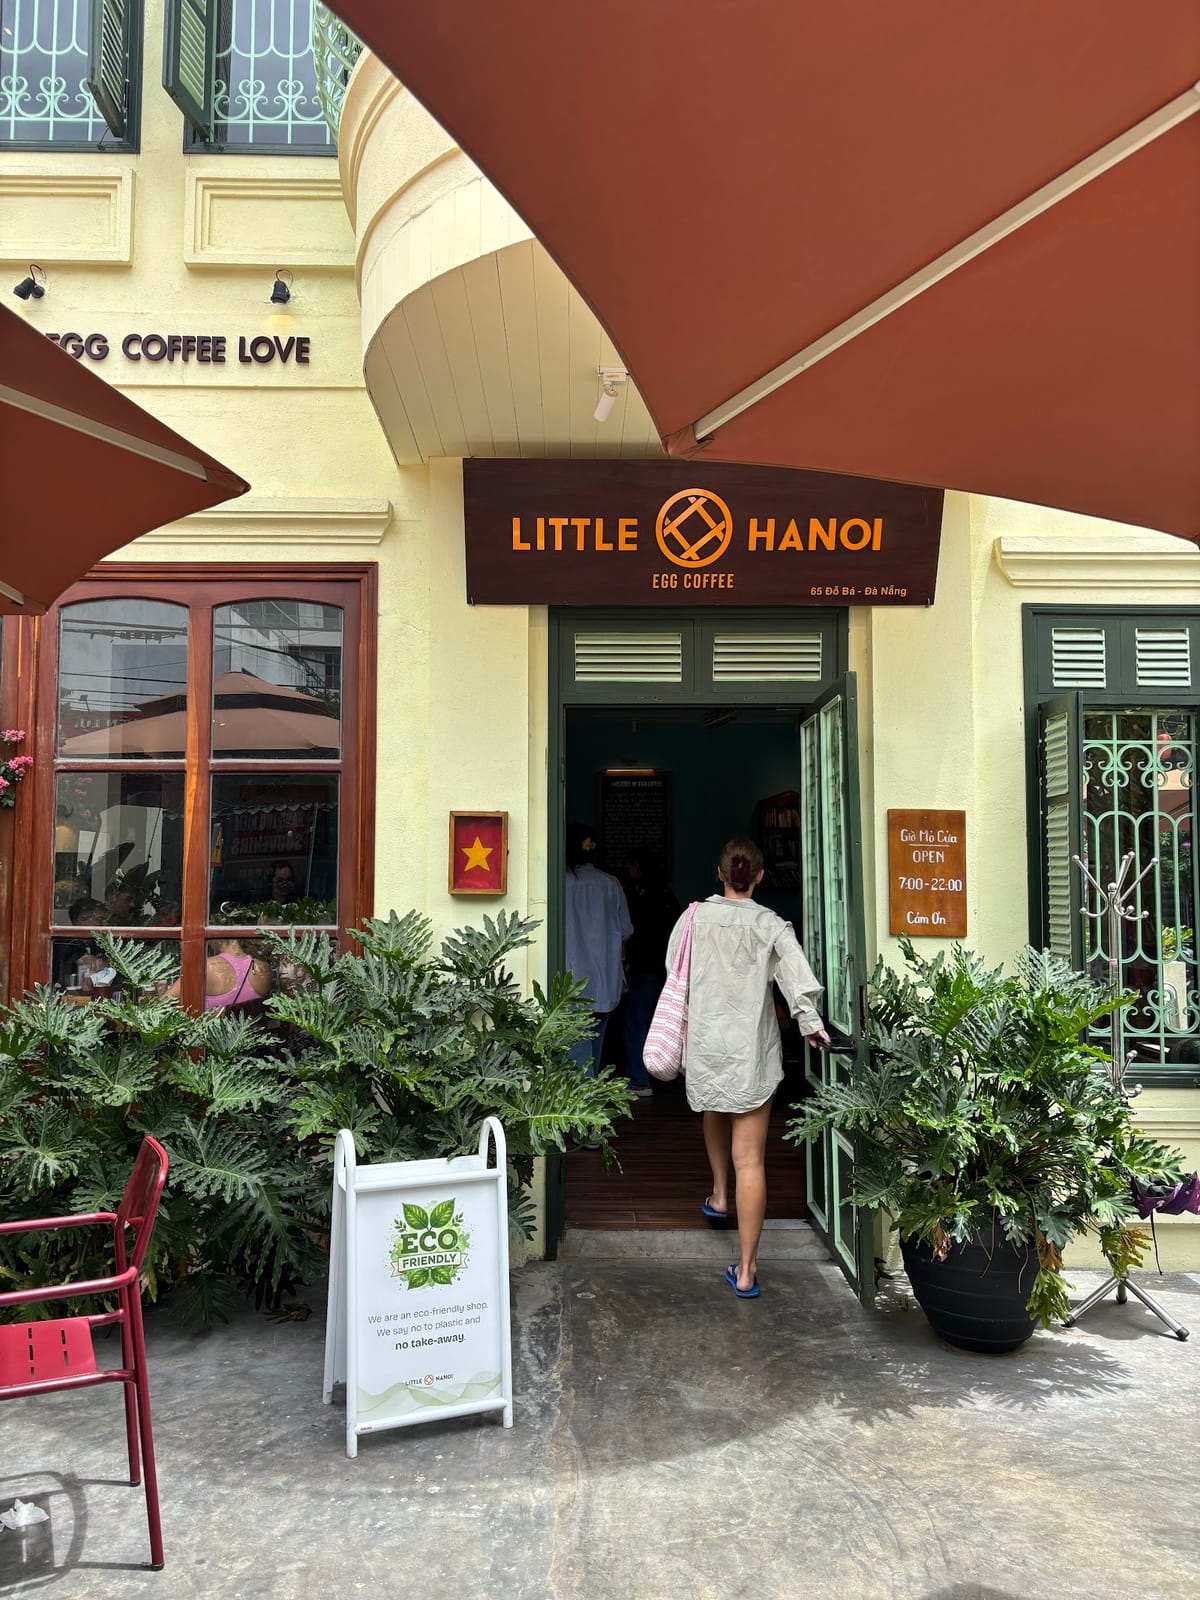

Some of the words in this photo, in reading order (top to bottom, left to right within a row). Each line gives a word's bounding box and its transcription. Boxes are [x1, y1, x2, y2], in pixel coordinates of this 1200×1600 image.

[122, 333, 226, 362] COFFEE
[238, 335, 311, 364] LOVE
[511, 517, 638, 551] LITTLE
[748, 517, 883, 551] HANOI
[652, 573, 678, 589] EGG
[683, 573, 734, 589] COFFEE
[810, 586, 823, 596] 65
[842, 586, 855, 596] Bá
[864, 586, 878, 596] Đà
[912, 850, 945, 863] OPEN
[400, 1229, 459, 1254] ECO
[402, 1253, 458, 1269] FRIENDLY
[368, 1315, 382, 1324] We
[384, 1314, 398, 1322] are
[400, 1312, 411, 1320] an
[413, 1304, 465, 1319] eco-friendly
[466, 1302, 489, 1313] shop.
[376, 1328, 391, 1337] We
[392, 1327, 409, 1336] say
[410, 1325, 422, 1333] no
[424, 1323, 433, 1331] to
[435, 1318, 463, 1330] plastic
[464, 1315, 481, 1325] and
[395, 1341, 409, 1350] no
[411, 1333, 466, 1348] take-away.
[405, 1377, 423, 1386] LITTLE
